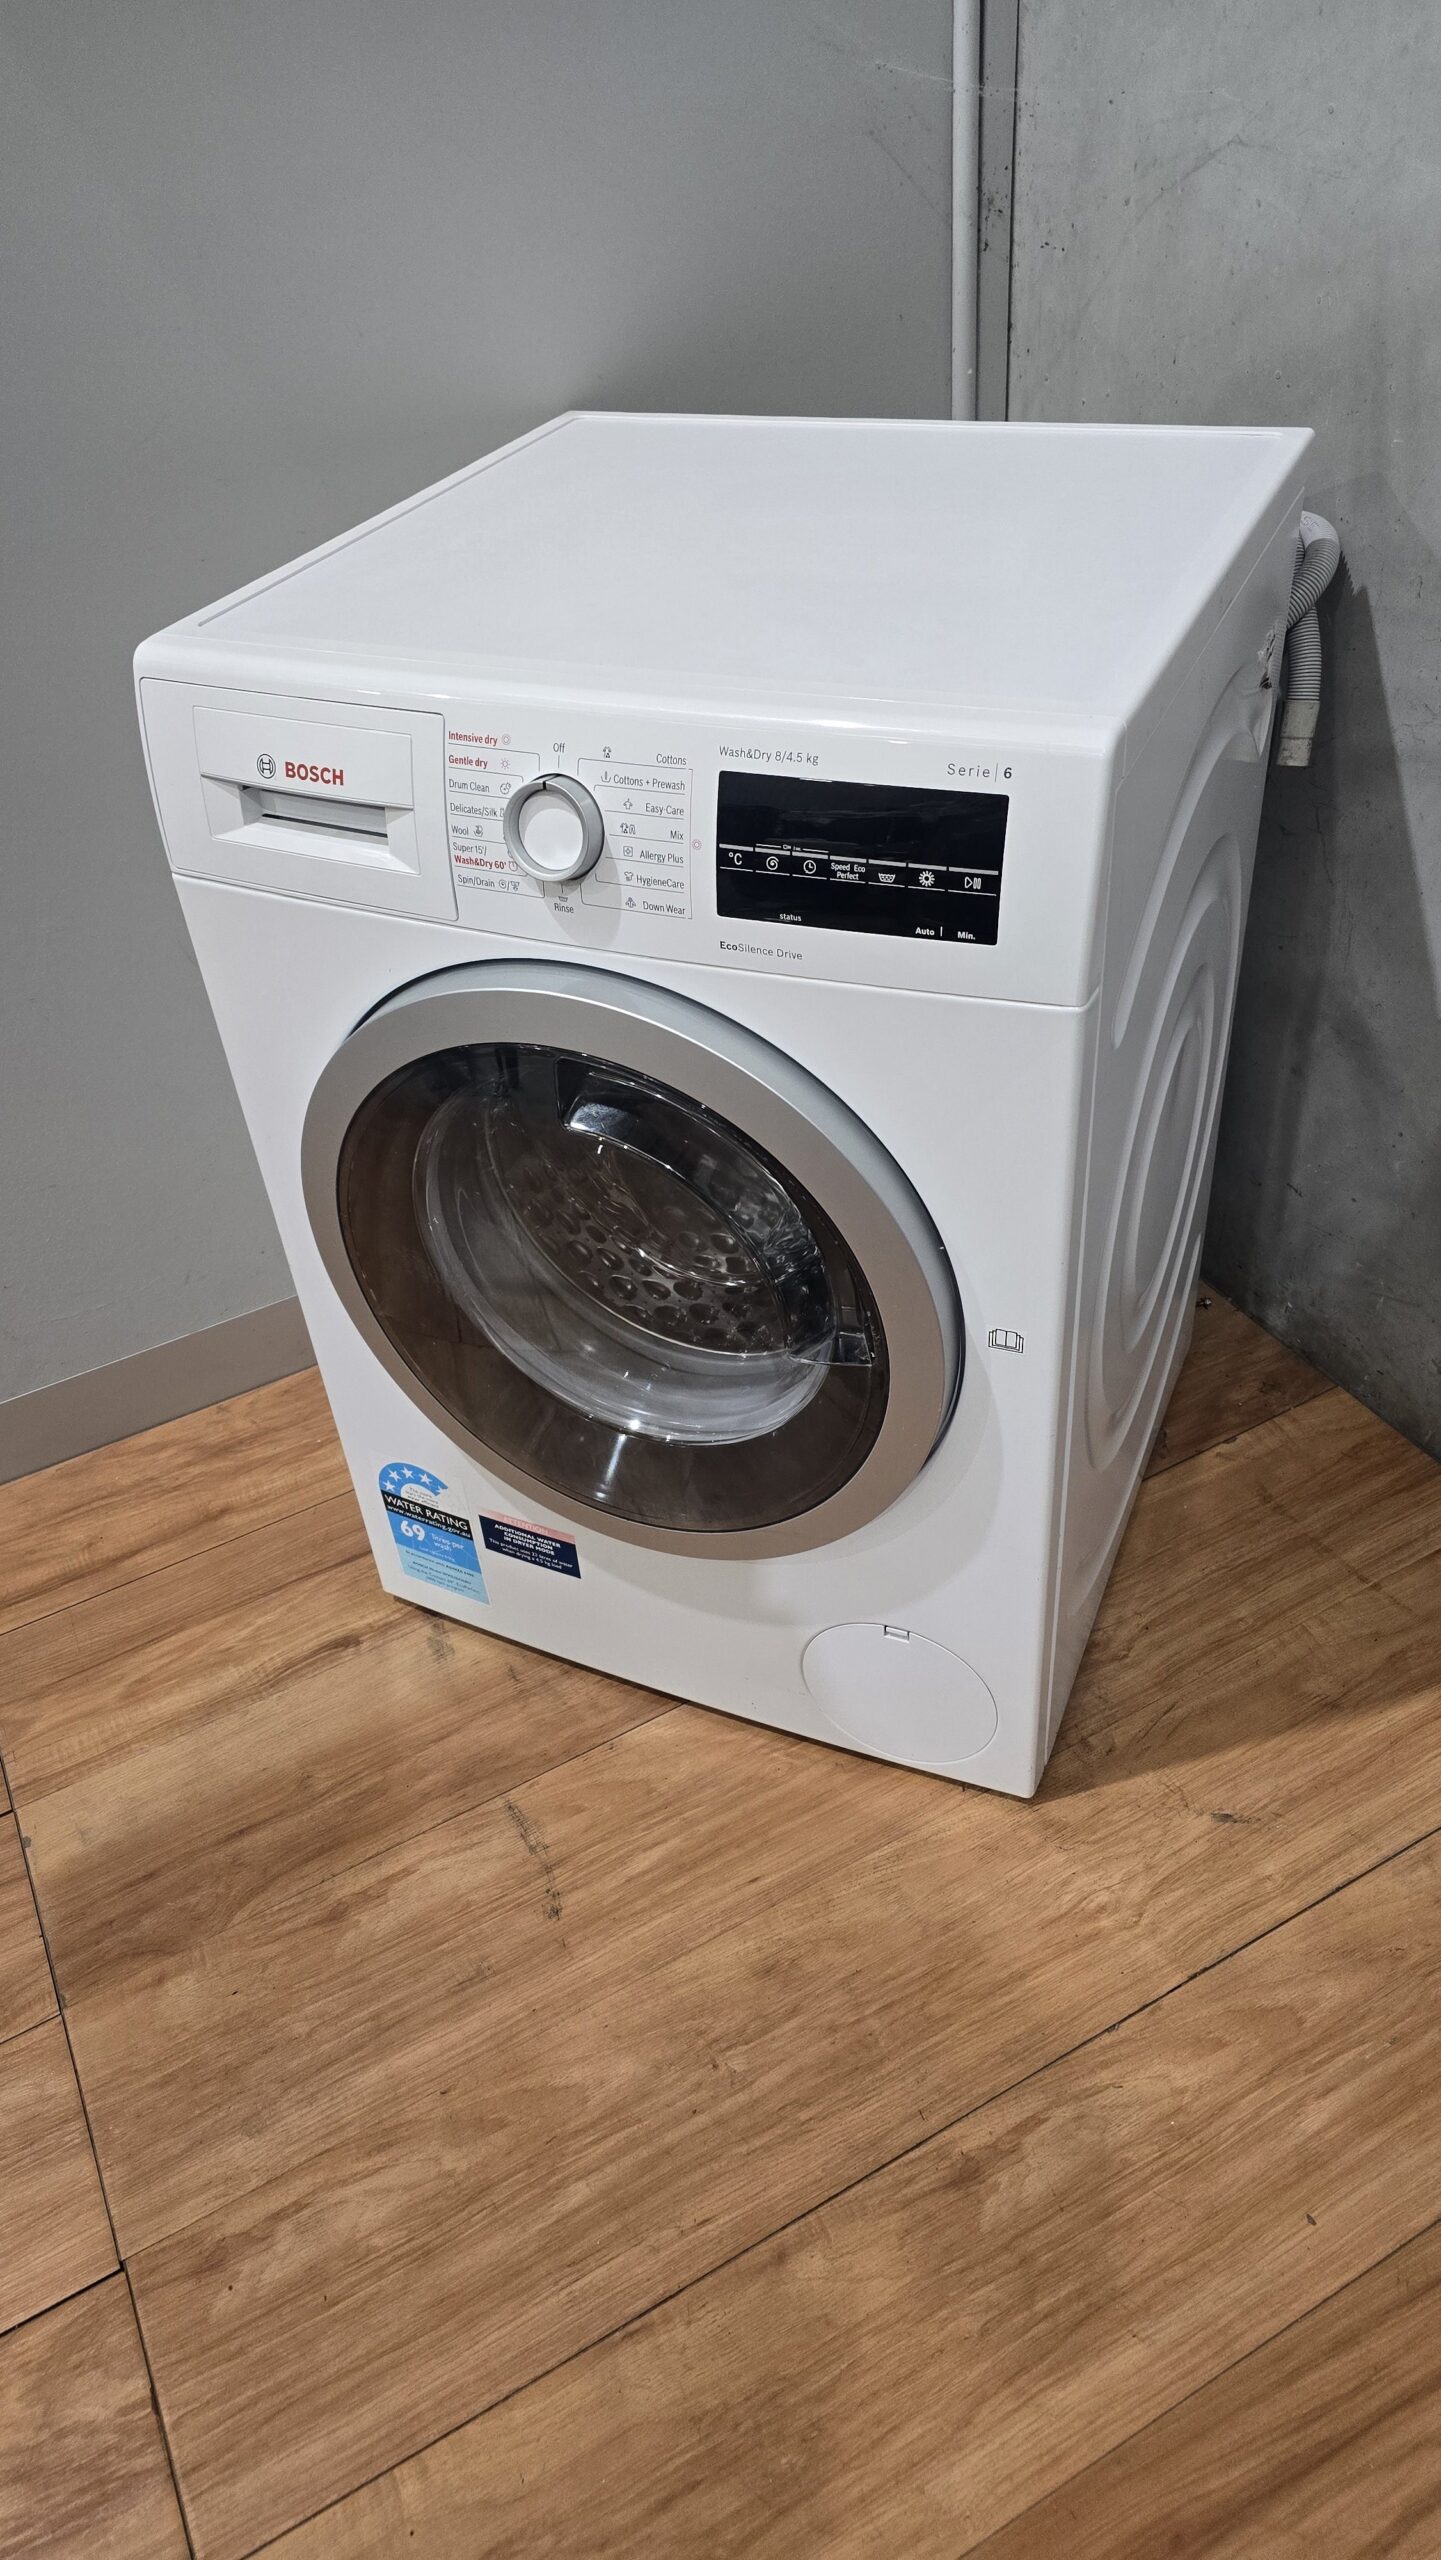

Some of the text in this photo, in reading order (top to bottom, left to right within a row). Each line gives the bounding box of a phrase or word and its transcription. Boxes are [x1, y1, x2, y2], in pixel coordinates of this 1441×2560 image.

[448, 731, 498, 747] Intensive dry
[553, 742, 565, 753] Off
[448, 755, 488, 770] Gentle dry
[656, 753, 687, 766] Cottons
[719, 745, 819, 766] Wash&Dry 8/4.5 kg
[285, 761, 344, 786] BOSCH
[947, 763, 1012, 780] Serie 6
[449, 779, 490, 793] Drum Clean
[614, 774, 644, 787] Cottons
[652, 778, 685, 791] Prewash
[450, 803, 498, 818] Delicates/Silk
[451, 825, 469, 836] Wool
[670, 830, 684, 841] Mix
[452, 842, 474, 853] Super
[454, 854, 494, 870] Wash&Dry
[640, 850, 684, 864] Allergy Plus
[830, 862, 866, 873] Speed Eco
[458, 874, 495, 888] Spin/Drain
[636, 874, 685, 890] HygieneCare
[836, 871, 860, 880] Perfect
[554, 902, 574, 914] Rinse
[642, 900, 686, 916] Down Wear
[779, 912, 802, 922] status
[915, 926, 935, 937] Auto
[957, 931, 976, 941] Min.
[720, 940, 803, 961] EcoSilence Drive
[384, 1494, 424, 1515] WATER
[426, 1509, 468, 1531] RATING
[386, 1505, 471, 1538] www.waterrating.gov.au
[400, 1520, 426, 1542] 69
[494, 1524, 561, 1548] ADDITIONAL WATER
[504, 1531, 554, 1550] CONSUMPTION
[512, 1538, 534, 1550] DRYER
[535, 1546, 556, 1556] MODE
